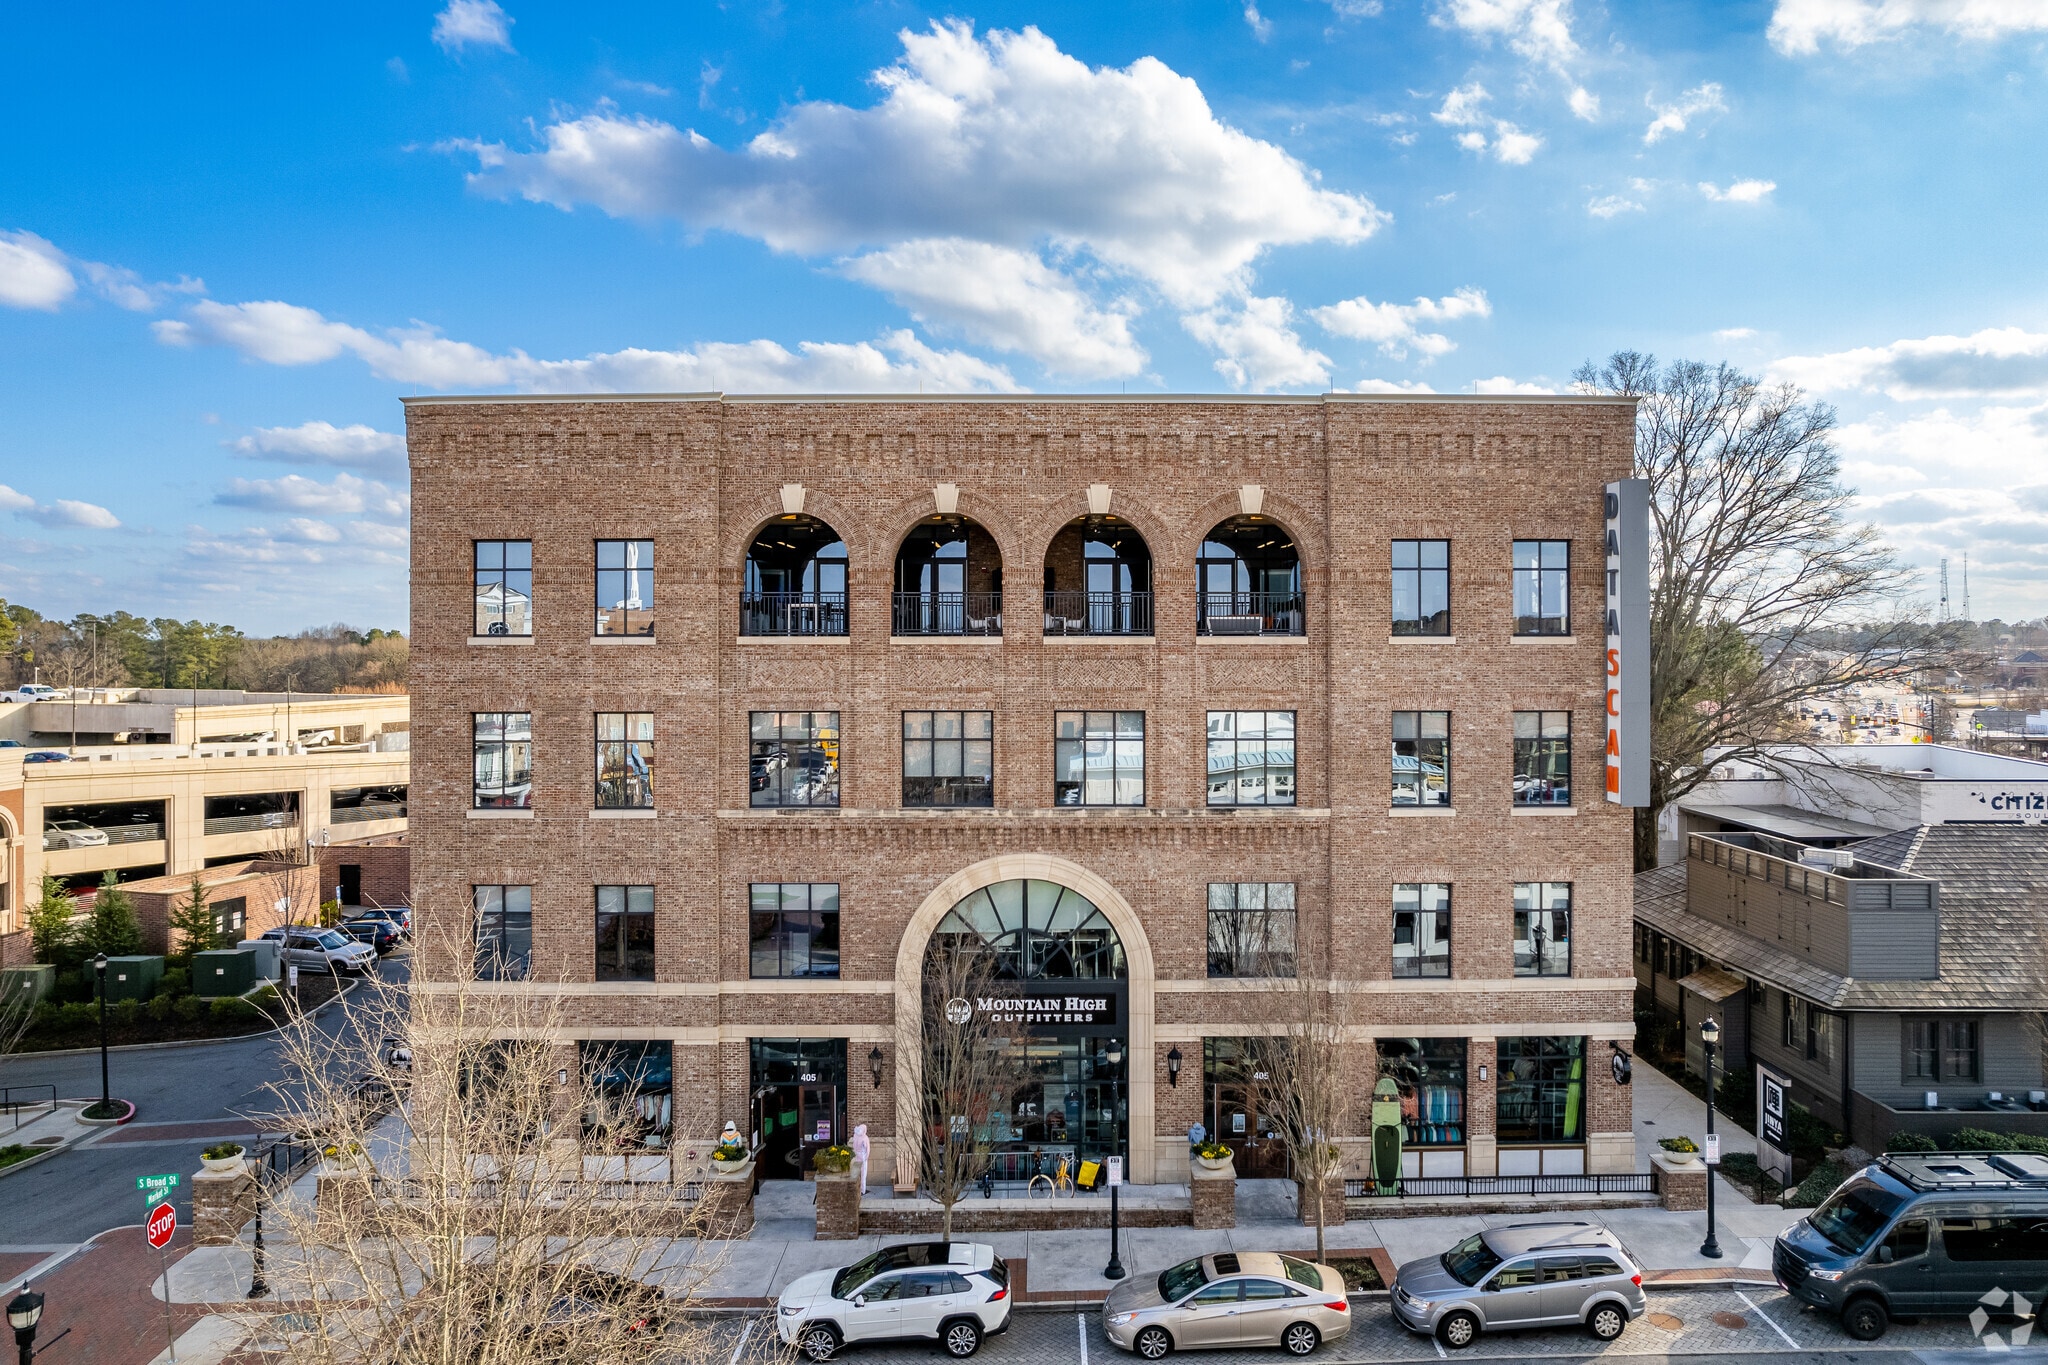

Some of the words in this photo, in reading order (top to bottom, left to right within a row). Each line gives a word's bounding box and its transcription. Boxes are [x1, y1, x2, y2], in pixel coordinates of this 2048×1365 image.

[1605, 492, 1619, 794] DATASCAN
[1991, 796, 2048, 809] CITIZ
[977, 998, 1061, 1011] MOUNTAIN
[1064, 997, 1107, 1011] HIGH
[991, 1013, 1093, 1022] OUTFITTERS
[800, 1073, 816, 1081] 405
[1764, 1112, 1783, 1132] JINYA
[139, 1178, 144, 1188] S
[146, 1177, 167, 1187] Broad
[169, 1175, 177, 1185] St
[150, 1212, 174, 1240] STOP
